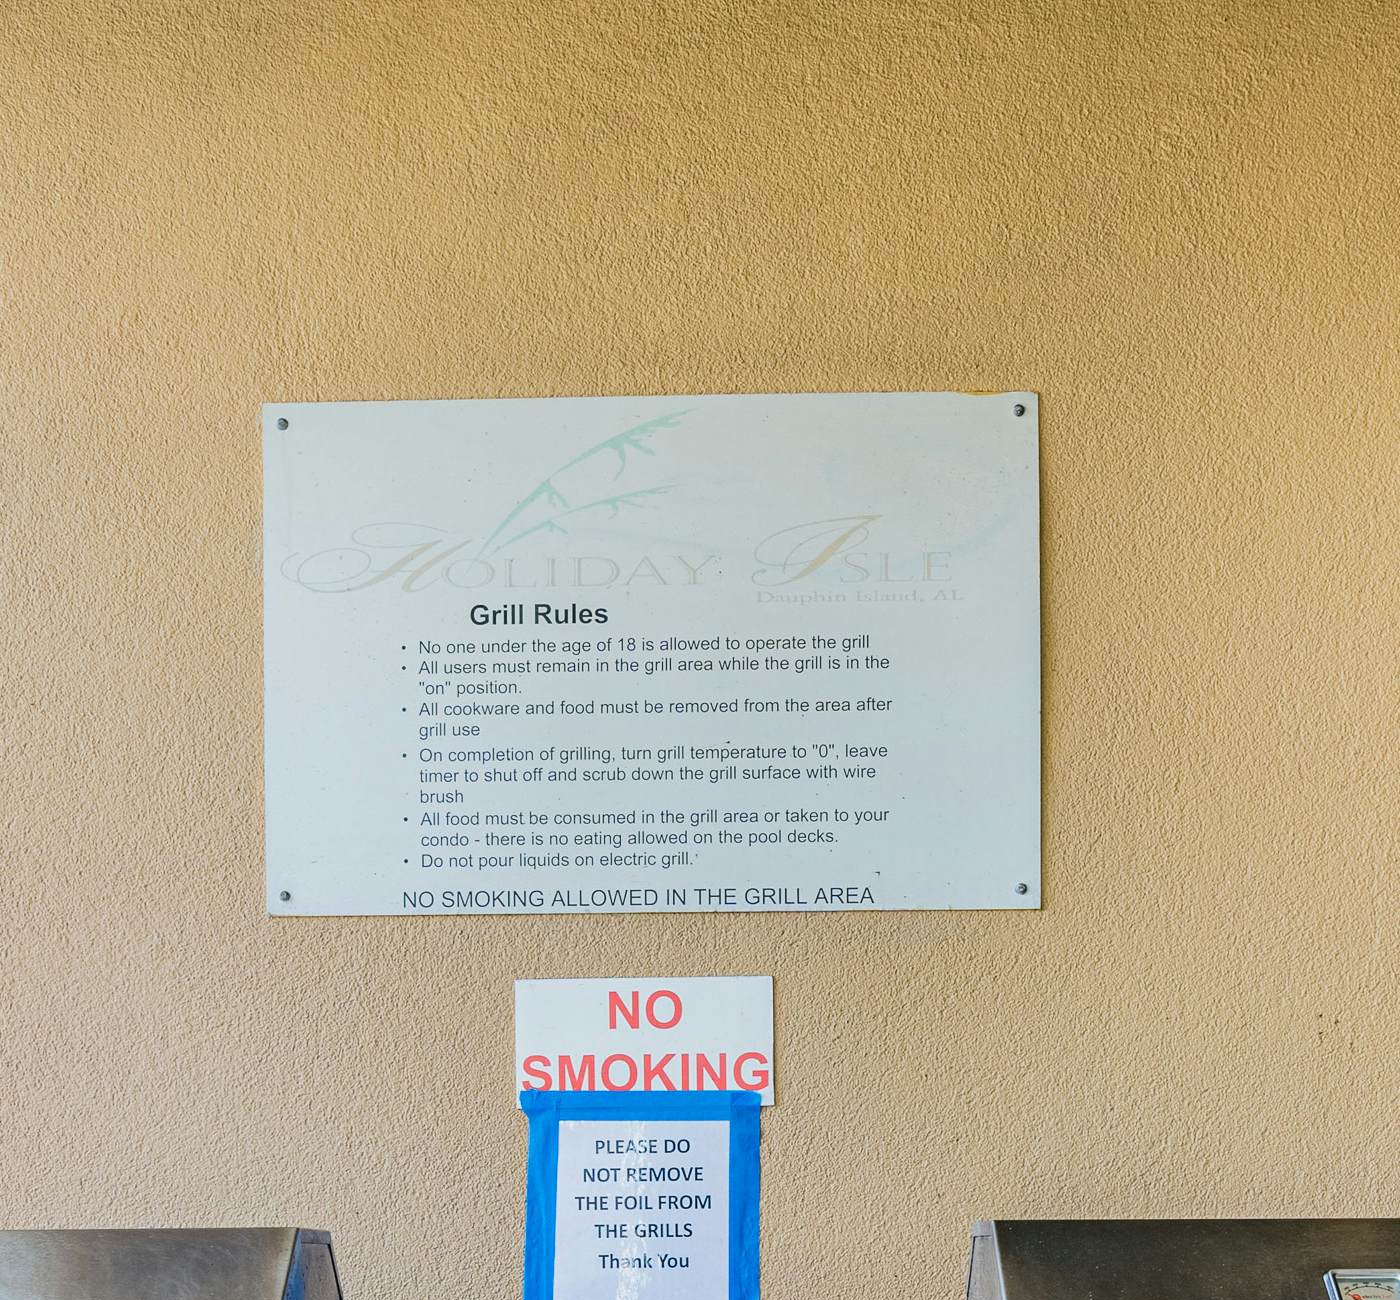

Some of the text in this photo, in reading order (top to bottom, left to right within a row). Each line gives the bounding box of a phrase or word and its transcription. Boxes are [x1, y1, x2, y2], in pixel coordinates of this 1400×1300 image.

[469, 603, 609, 626] Grill Rules
[419, 634, 870, 656] No one under the age of 18 is allowed to operate the grill
[418, 655, 890, 676] All users must remain in the grill area while the grill is in the
[419, 680, 522, 698] "on" position.
[418, 696, 893, 717] All cookware and food must be removed from the area after
[419, 722, 481, 741] grill use
[419, 743, 888, 765] On completion of grilling, turn grill temperature to "0", leave
[419, 764, 876, 784] timer to shut off and scrub down the grill surface with wire
[420, 789, 464, 804] brush
[420, 808, 890, 827] All food must be consumed in the grill area or taken to your
[420, 828, 838, 849] condo there is no eating allowed on the pool decks.
[421, 851, 693, 871] Do not pour liquids on electric grill.
[403, 886, 875, 909] NO SMOKING ALLOWED IN THE GRILL AREA
[608, 990, 683, 1030] NO
[521, 1052, 770, 1092] SMOKING
[594, 1139, 691, 1154] PLEASE DO
[583, 1167, 704, 1183] NOT REMOVE
[575, 1195, 712, 1211] THE FOIL FROM
[594, 1223, 693, 1239] THE GRILLS
[598, 1253, 690, 1269] Thank You
